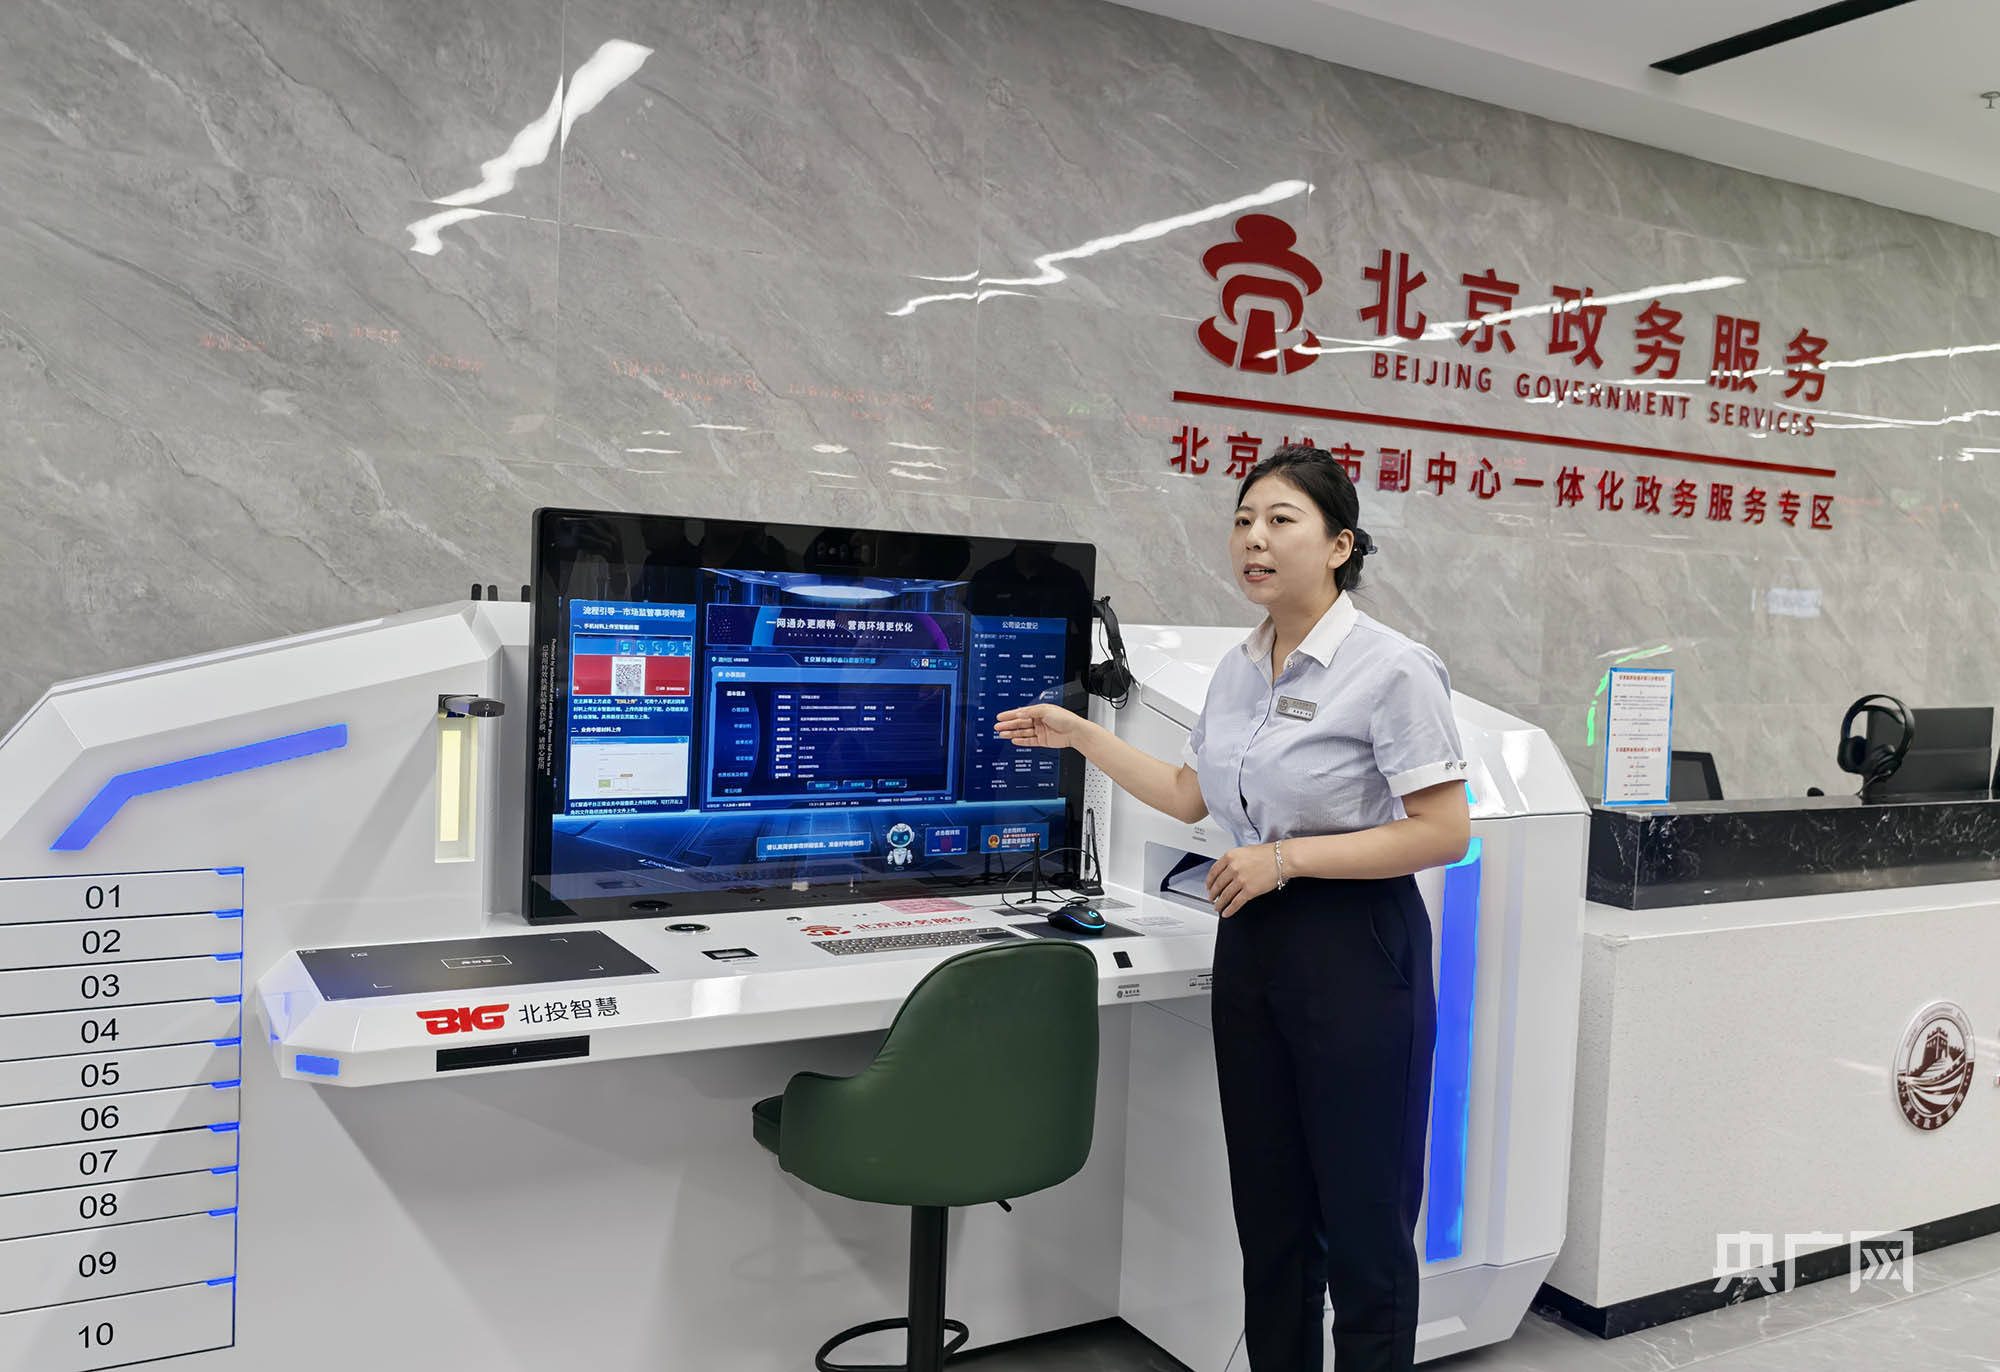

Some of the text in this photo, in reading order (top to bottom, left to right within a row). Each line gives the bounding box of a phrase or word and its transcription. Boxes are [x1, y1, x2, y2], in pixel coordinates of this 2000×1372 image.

[1360, 249, 1832, 402] 北京政务服务
[1372, 352, 1816, 437] BEIJING GOVERNMENT SERVICES
[1170, 426, 1834, 530] 北京市副中心一体化政务服务专区
[85, 885, 120, 909] 01
[82, 929, 121, 954] 02
[81, 974, 120, 999] 03
[518, 996, 620, 1025] 北投智慧
[80, 1018, 119, 1043] 04
[80, 1062, 120, 1087] 05
[80, 1105, 119, 1131] 06
[79, 1149, 118, 1175] 07
[79, 1193, 117, 1219] 08
[78, 1251, 116, 1277] 09
[78, 1322, 114, 1348] 10
